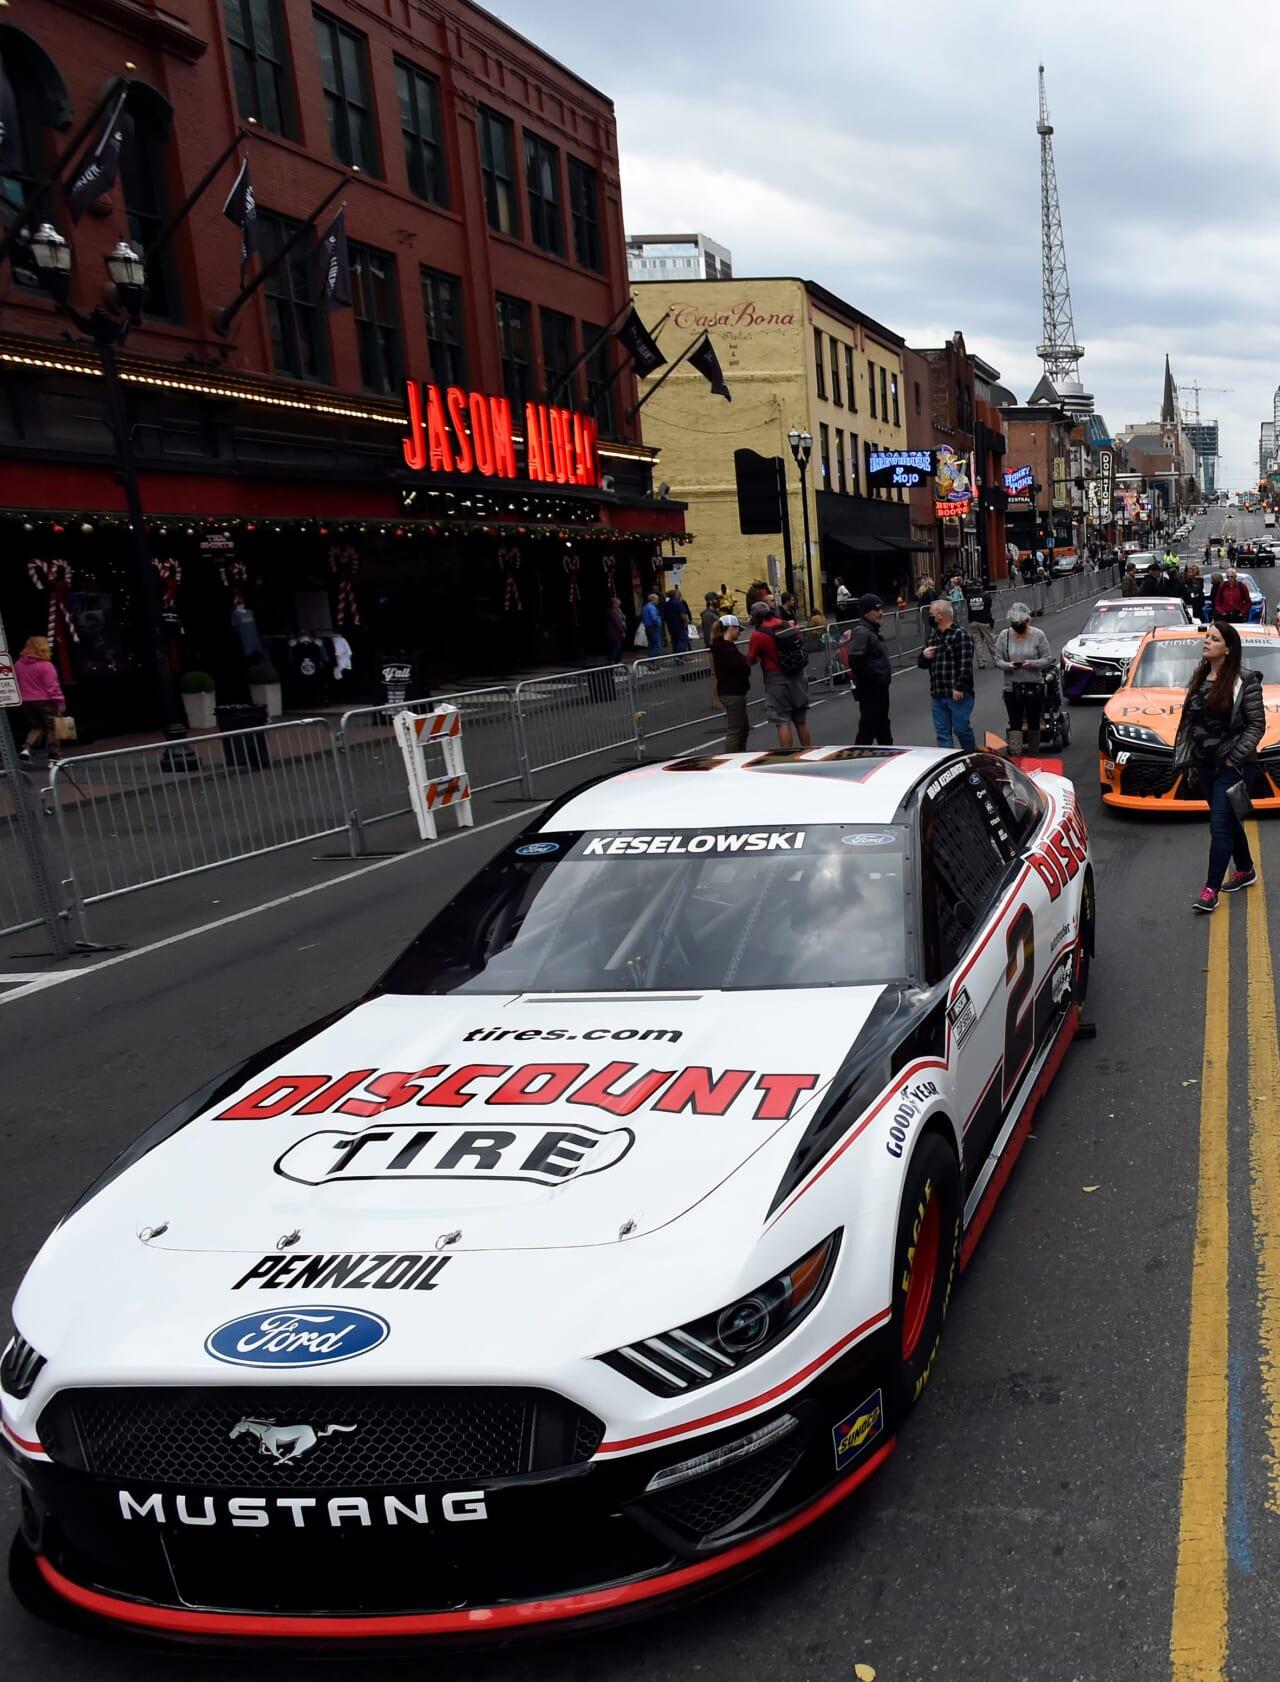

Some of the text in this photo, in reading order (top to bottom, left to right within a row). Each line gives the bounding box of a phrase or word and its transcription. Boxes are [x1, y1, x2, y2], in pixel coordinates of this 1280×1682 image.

[669, 301, 795, 328] Casa Bona
[402, 380, 516, 479] JASON
[893, 473, 919, 487] MOJO
[936, 500, 970, 510] BETTY
[938, 507, 969, 517] BOOTS
[1115, 751, 1131, 765] 18
[582, 831, 805, 856] KESELOWSKI
[461, 1026, 684, 1044] tires.com
[210, 1060, 821, 1122] DISCOUNT
[325, 1130, 601, 1177] TIRE
[231, 1253, 453, 1291] PENNZOIL
[236, 1313, 356, 1354] Ford
[837, 1407, 881, 1454] SUNOCO
[118, 1490, 489, 1528] MUSTANG
